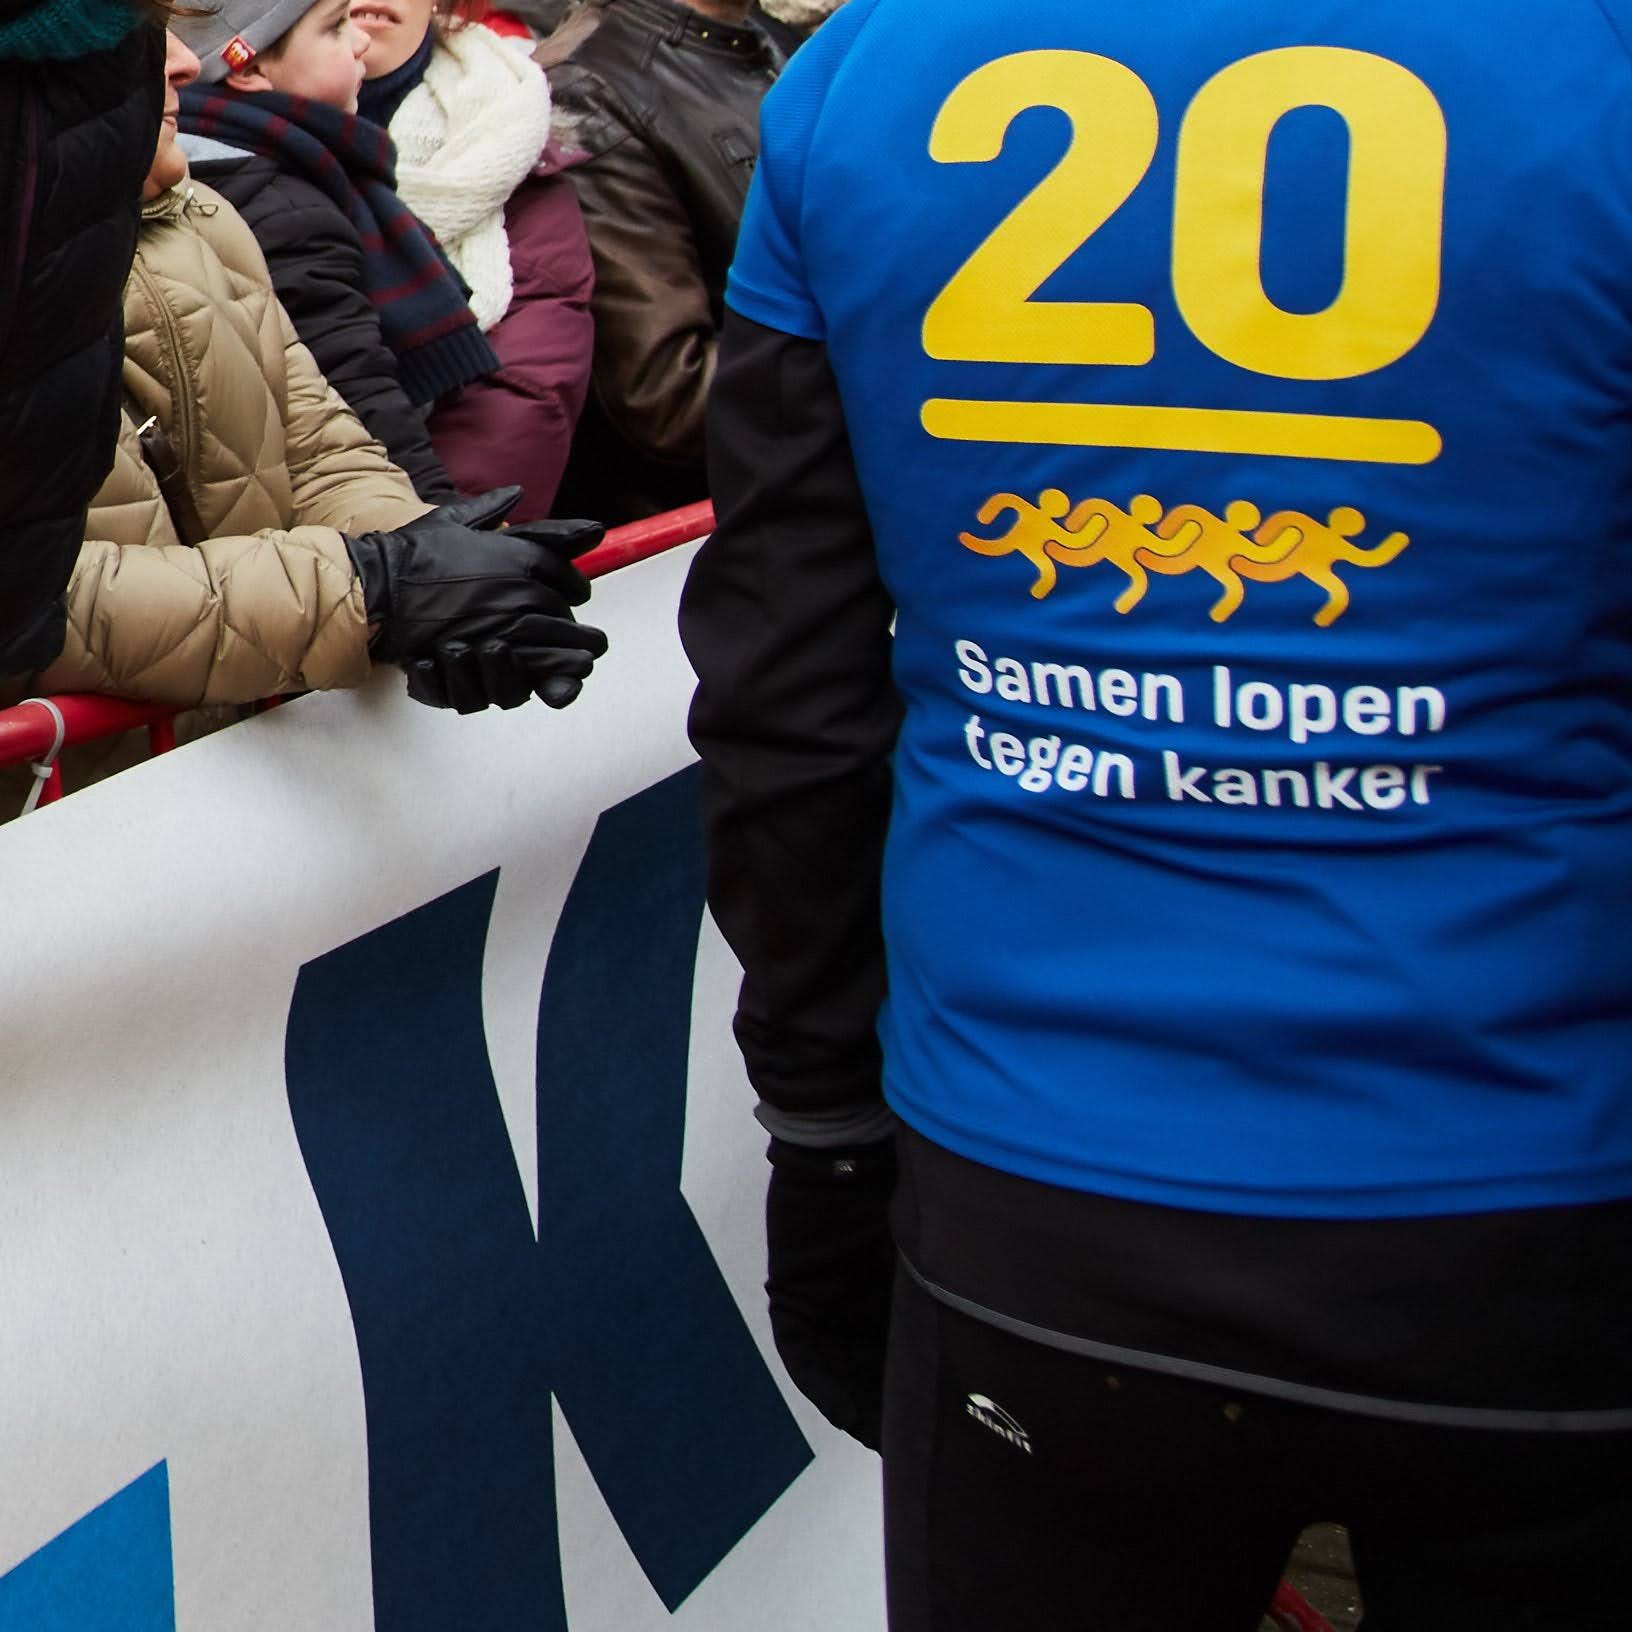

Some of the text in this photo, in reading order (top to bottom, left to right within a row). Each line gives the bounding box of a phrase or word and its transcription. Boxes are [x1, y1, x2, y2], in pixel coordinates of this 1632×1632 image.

[921, 44, 1448, 381] 20
[954, 638, 1447, 746] Samen lopen
[963, 712, 1444, 812] tegen kanker
